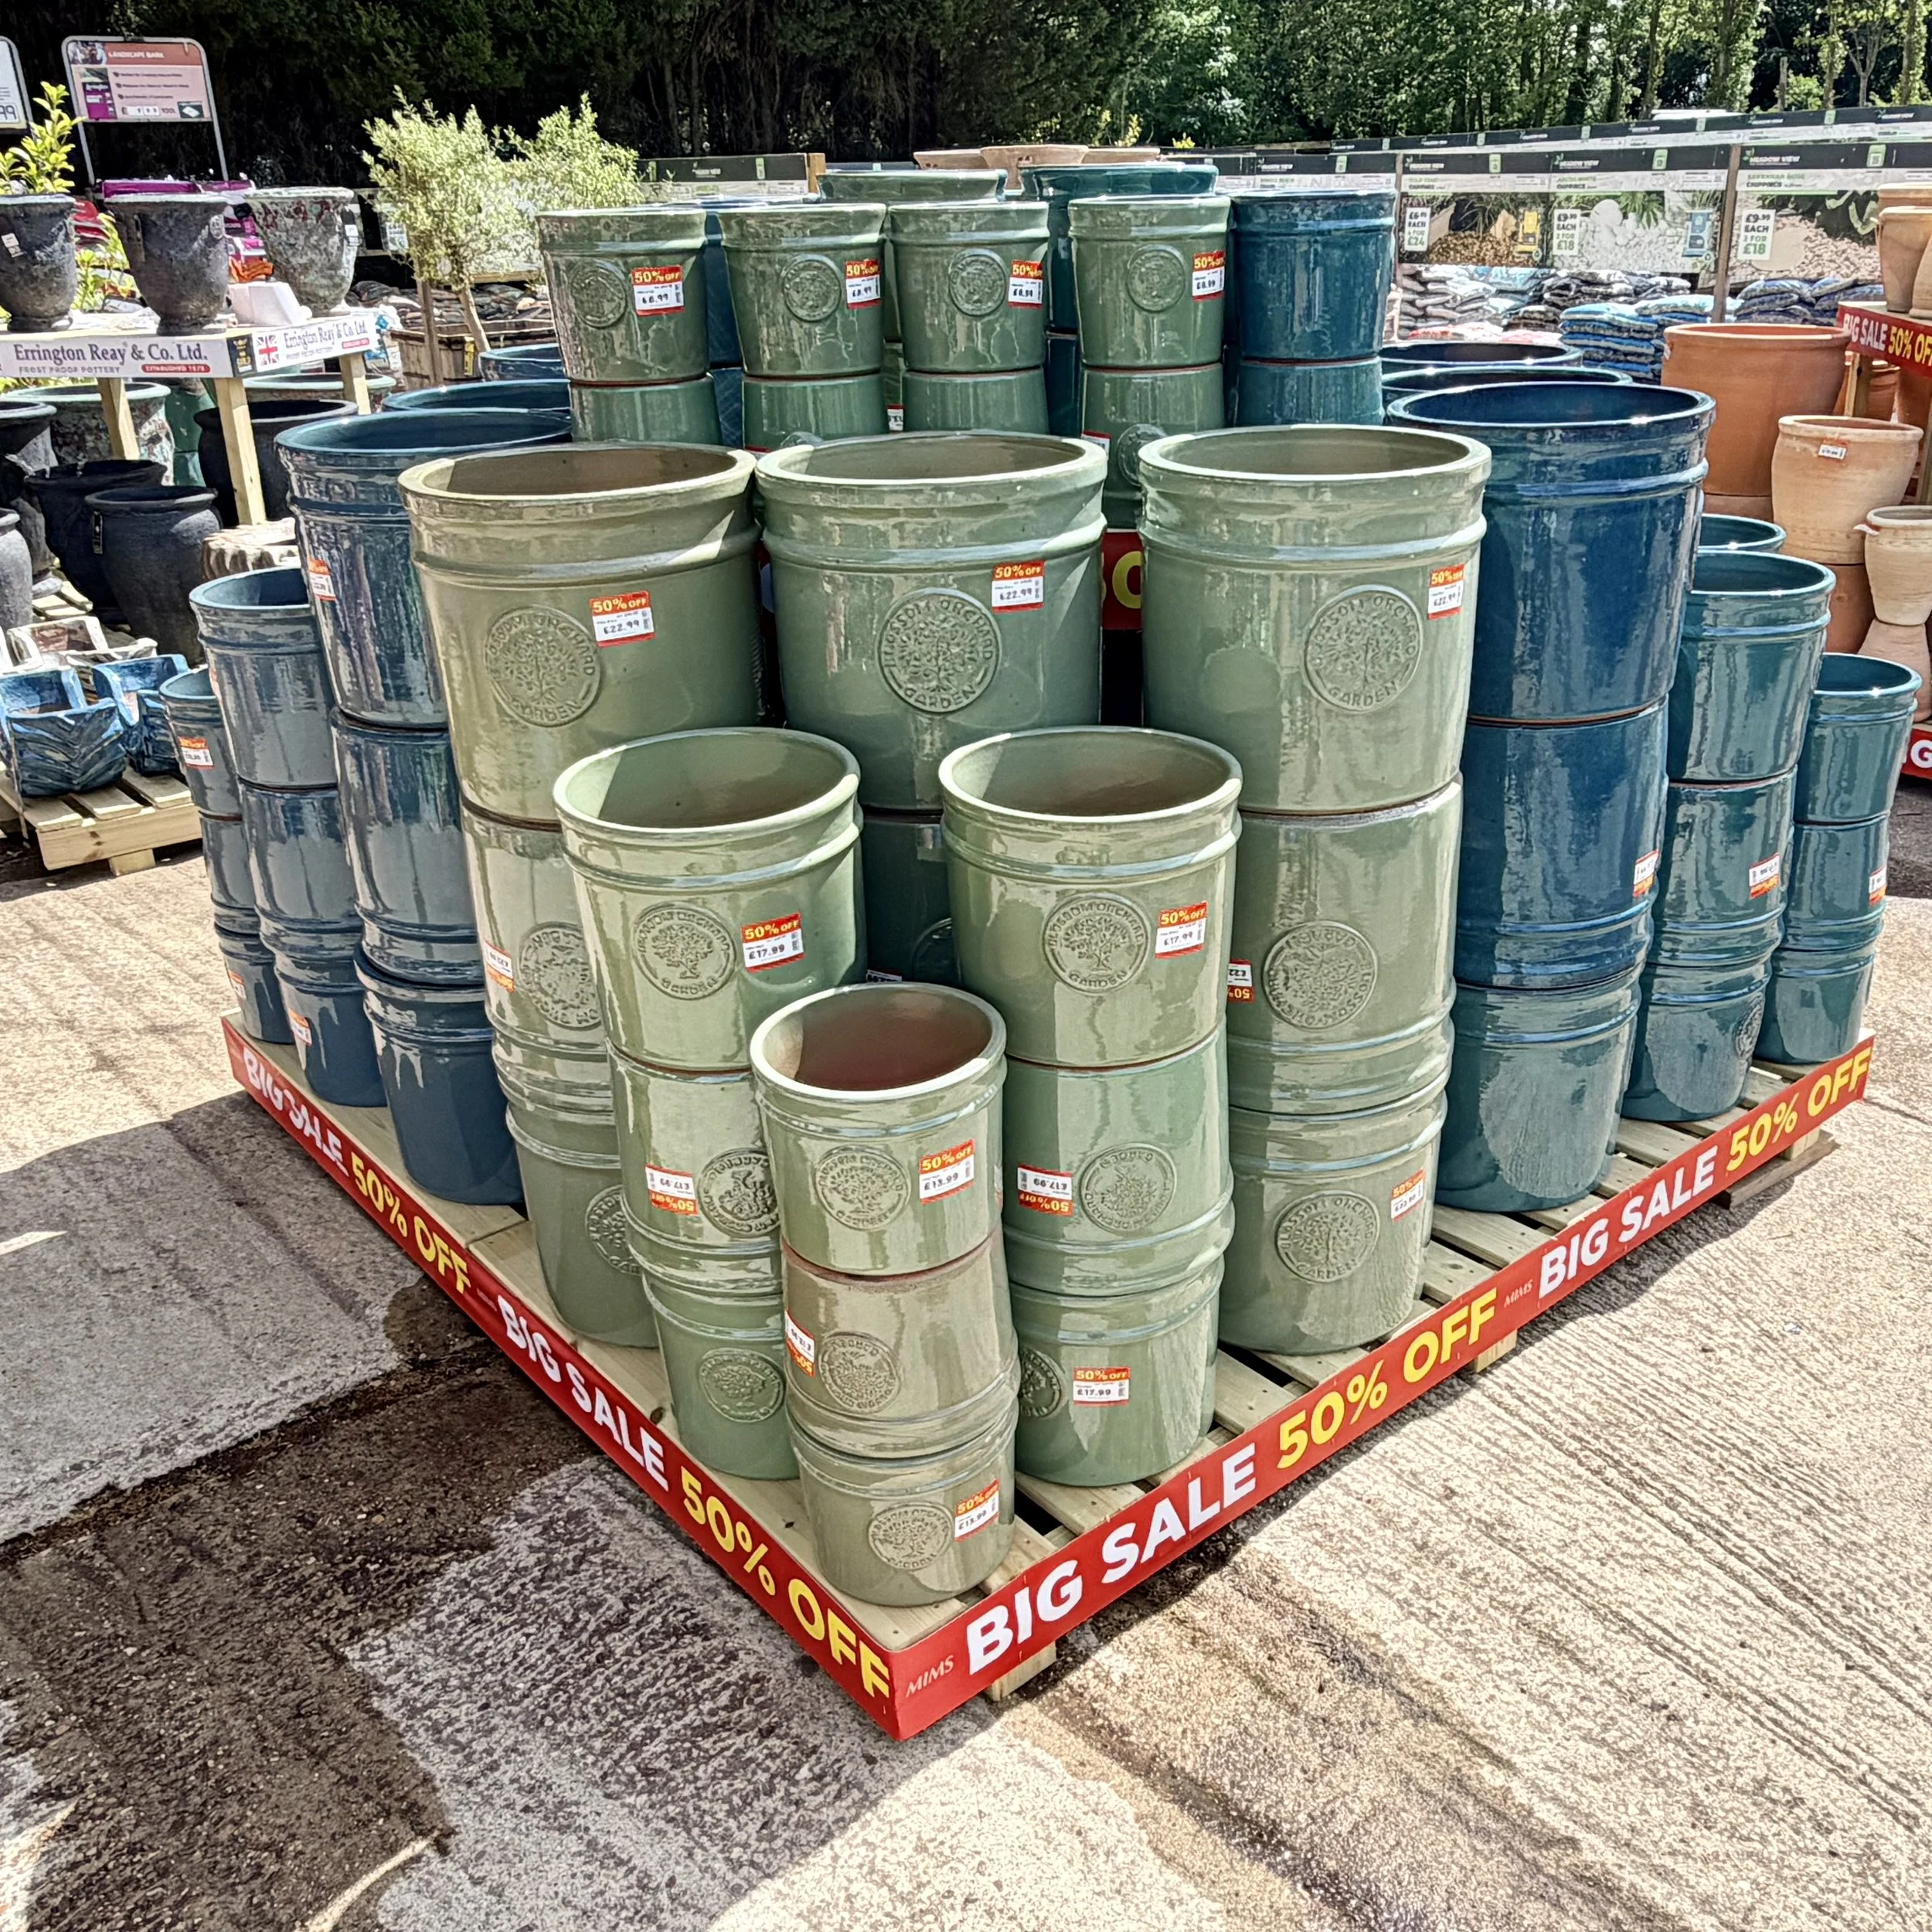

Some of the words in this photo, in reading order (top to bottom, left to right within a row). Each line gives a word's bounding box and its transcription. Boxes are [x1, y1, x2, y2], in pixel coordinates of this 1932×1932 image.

[1746, 213, 1770, 223] £9.99
[1557, 240, 1574, 250] £18
[1743, 243, 1766, 254] £18
[846, 264, 867, 276] 50%
[1012, 264, 1034, 277] 50%
[1194, 257, 1215, 269] 50%
[634, 270, 664, 283] 50%
[1843, 313, 1860, 342] BIG
[1860, 318, 1888, 352] SALE
[1888, 325, 1913, 359] 50%
[1915, 333, 1932, 366] OF
[13, 344, 86, 366] Errington
[88, 343, 125, 366] Reay
[131, 345, 145, 361] &
[148, 344, 174, 361] Co.
[178, 343, 209, 361] Ltd.
[81, 366, 121, 374] POTTERY
[995, 565, 1024, 578] 50%
[1431, 570, 1452, 585] 50%
[593, 597, 628, 613] 50%
[604, 620, 639, 634] £22.99
[940, 599, 993, 660] ORCHARD
[904, 684, 976, 709] GARDEN
[1328, 681, 1398, 706] GARDEN
[1161, 910, 1189, 925] 50%
[745, 923, 779, 940] 50%
[781, 920, 799, 931] OFF
[749, 944, 785, 960] £17.99
[922, 1152, 954, 1171] 50%
[243, 1046, 283, 1111] BIG
[283, 1089, 349, 1177] SALE
[351, 1151, 408, 1237] 50%
[413, 1216, 471, 1294] OFF
[1503, 1279, 1534, 1308] MIMS
[1538, 1216, 1610, 1299] BIG
[1617, 1145, 1718, 1244] SALE
[1726, 1092, 1798, 1172] 50%
[1807, 1046, 1872, 1117] OFF
[924, 1172, 958, 1191] £13.99
[1037, 1196, 1070, 1213] 50%
[1076, 1369, 1107, 1380] 50%
[497, 1294, 561, 1383] BIG
[566, 1362, 668, 1492] SALE
[680, 1465, 776, 1596] 50%
[787, 1578, 889, 1699] OFF
[905, 1655, 954, 1698] MIMS
[966, 1559, 1083, 1675] BIG
[1101, 1442, 1256, 1585] SALE
[1277, 1359, 1388, 1469] 50%
[1403, 1287, 1497, 1383] OFF
[957, 1495, 985, 1515] 50%
